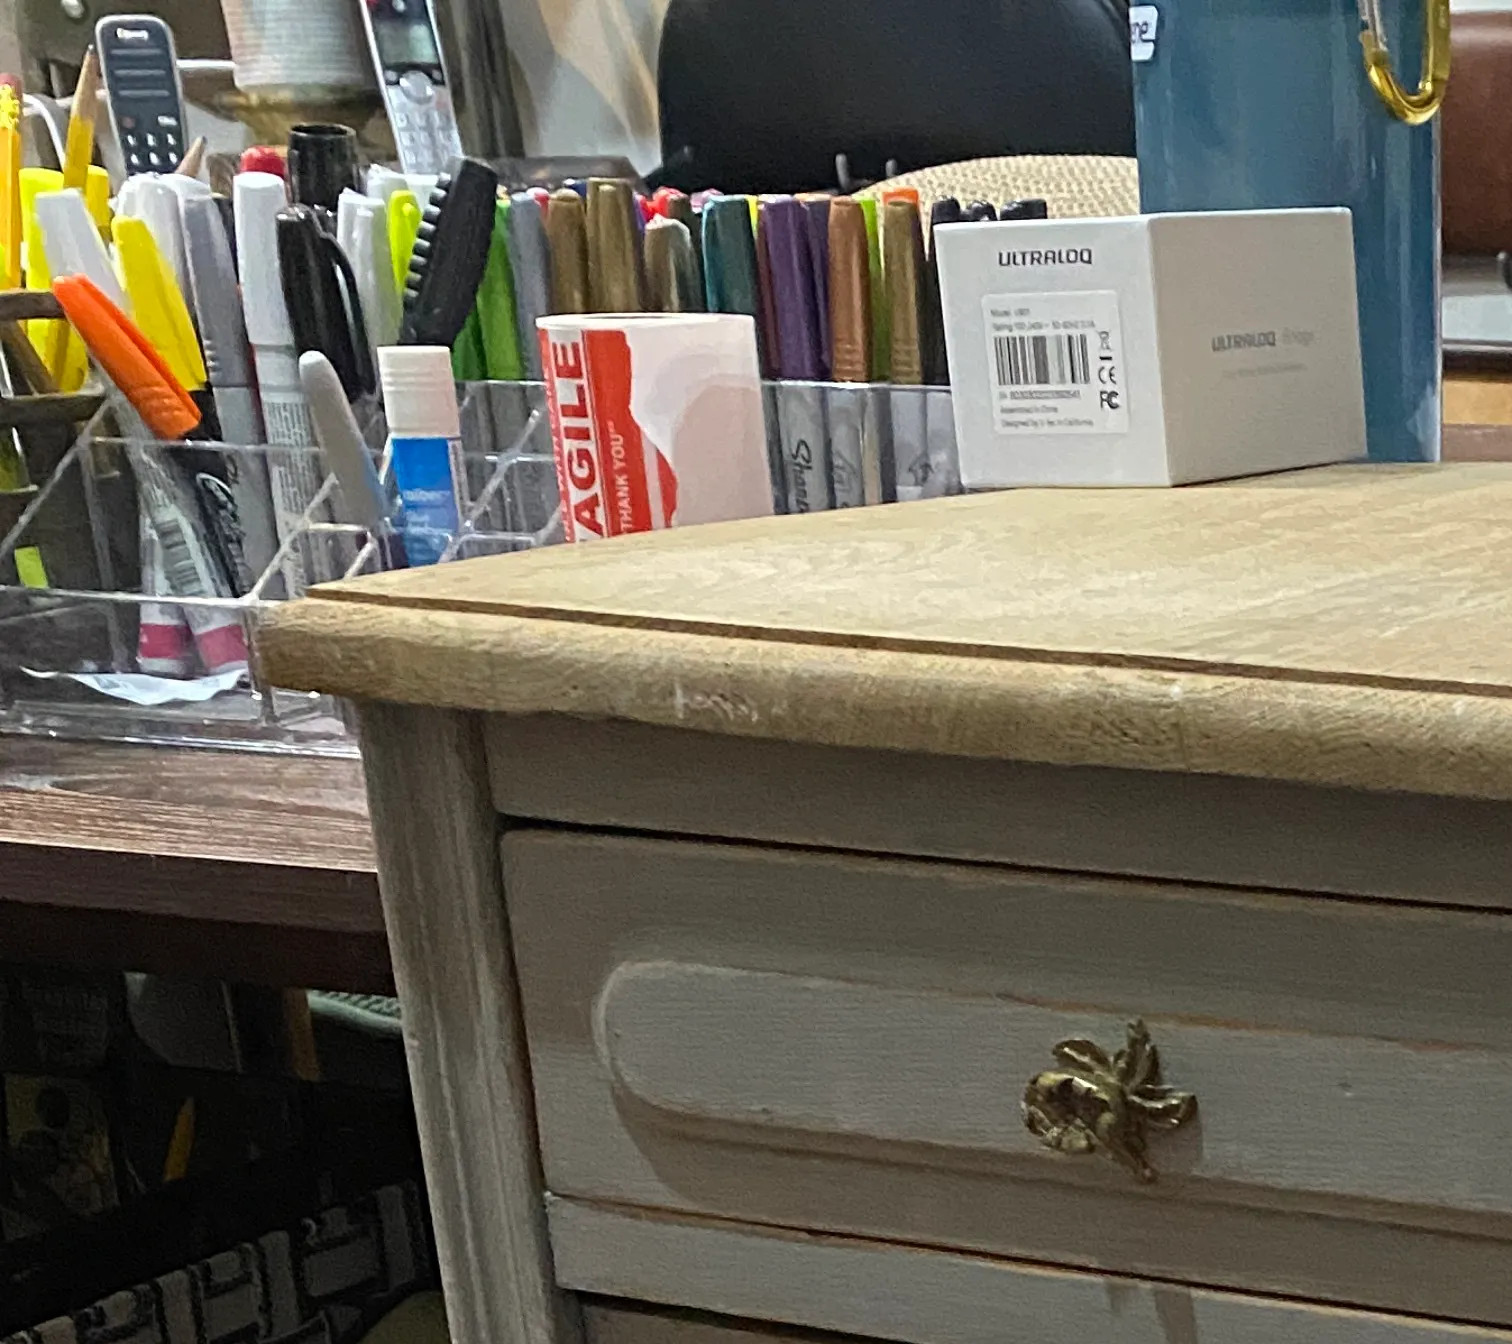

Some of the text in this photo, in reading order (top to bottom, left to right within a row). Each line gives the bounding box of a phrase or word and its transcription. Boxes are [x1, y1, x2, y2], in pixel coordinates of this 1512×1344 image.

[998, 247, 1092, 267] ULTRALOQ
[1211, 330, 1276, 352] ULTRALOQ
[552, 341, 605, 541] AGILE
